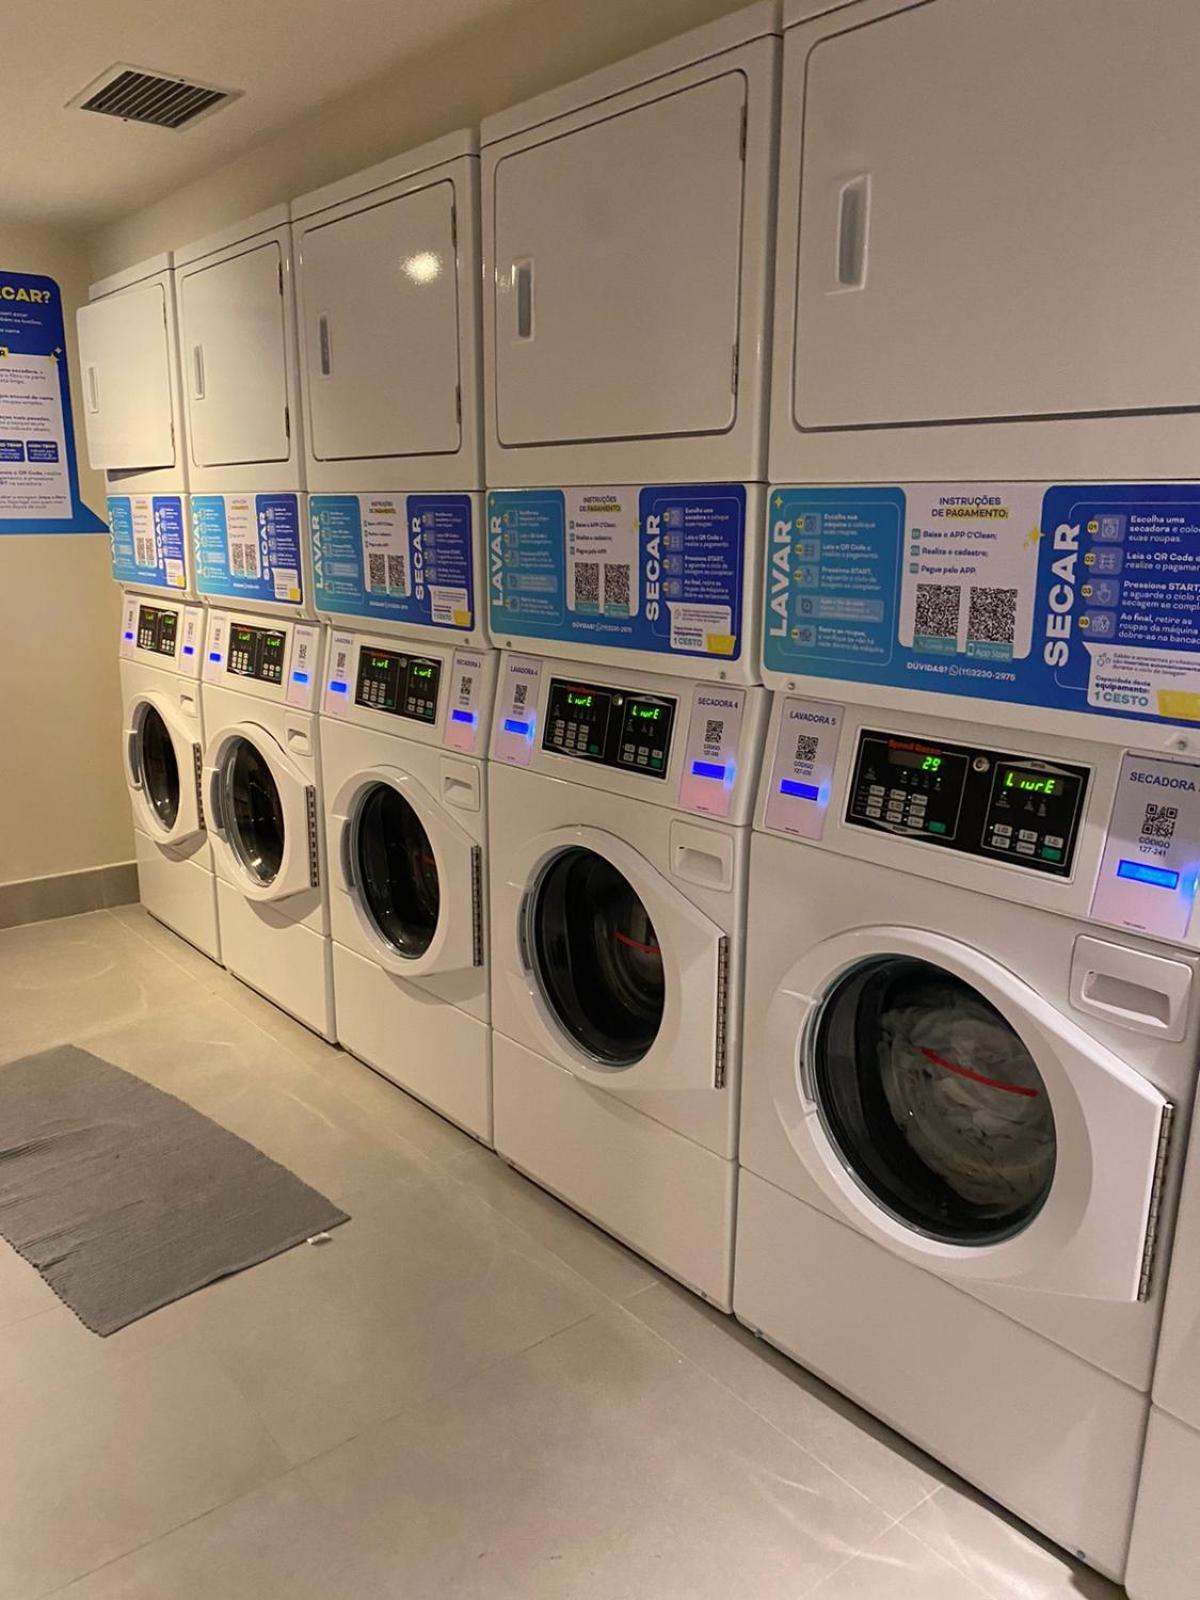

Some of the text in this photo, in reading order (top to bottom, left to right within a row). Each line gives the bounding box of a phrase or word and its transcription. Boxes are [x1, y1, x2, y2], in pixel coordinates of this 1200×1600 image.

[0, 286, 50, 303] CAR?
[939, 495, 1001, 508] INSTRUÇÕES
[932, 509, 944, 517] DE
[1131, 515, 1164, 524] Escolha
[312, 516, 323, 589] LAVAR
[412, 517, 424, 600] SECAR
[1127, 552, 1144, 560] Leia
[491, 516, 503, 606] LAVAR
[646, 515, 660, 621] SECAR
[943, 566, 958, 575] pelo
[770, 520, 792, 638] LAVAR
[1124, 581, 1166, 590] Pressione
[1044, 524, 1080, 667] SECAR
[1130, 591, 1164, 600] aguarde
[1173, 592, 1194, 601] ciclo
[1122, 600, 1158, 609] secagem
[1134, 613, 1153, 623] final,
[1155, 616, 1180, 624] retire
[1119, 630, 1156, 641] dobre-as
[1120, 623, 1148, 632] roupas
[1162, 626, 1198, 635] máquina
[698, 697, 733, 708] SECADORA
[1095, 691, 1148, 706] 1 CESTO
[790, 711, 836, 726] LAVADORA 5
[922, 756, 941, 771] 29
[1129, 771, 1196, 792] SECADORA
[1138, 836, 1170, 849] CÓDIGO
